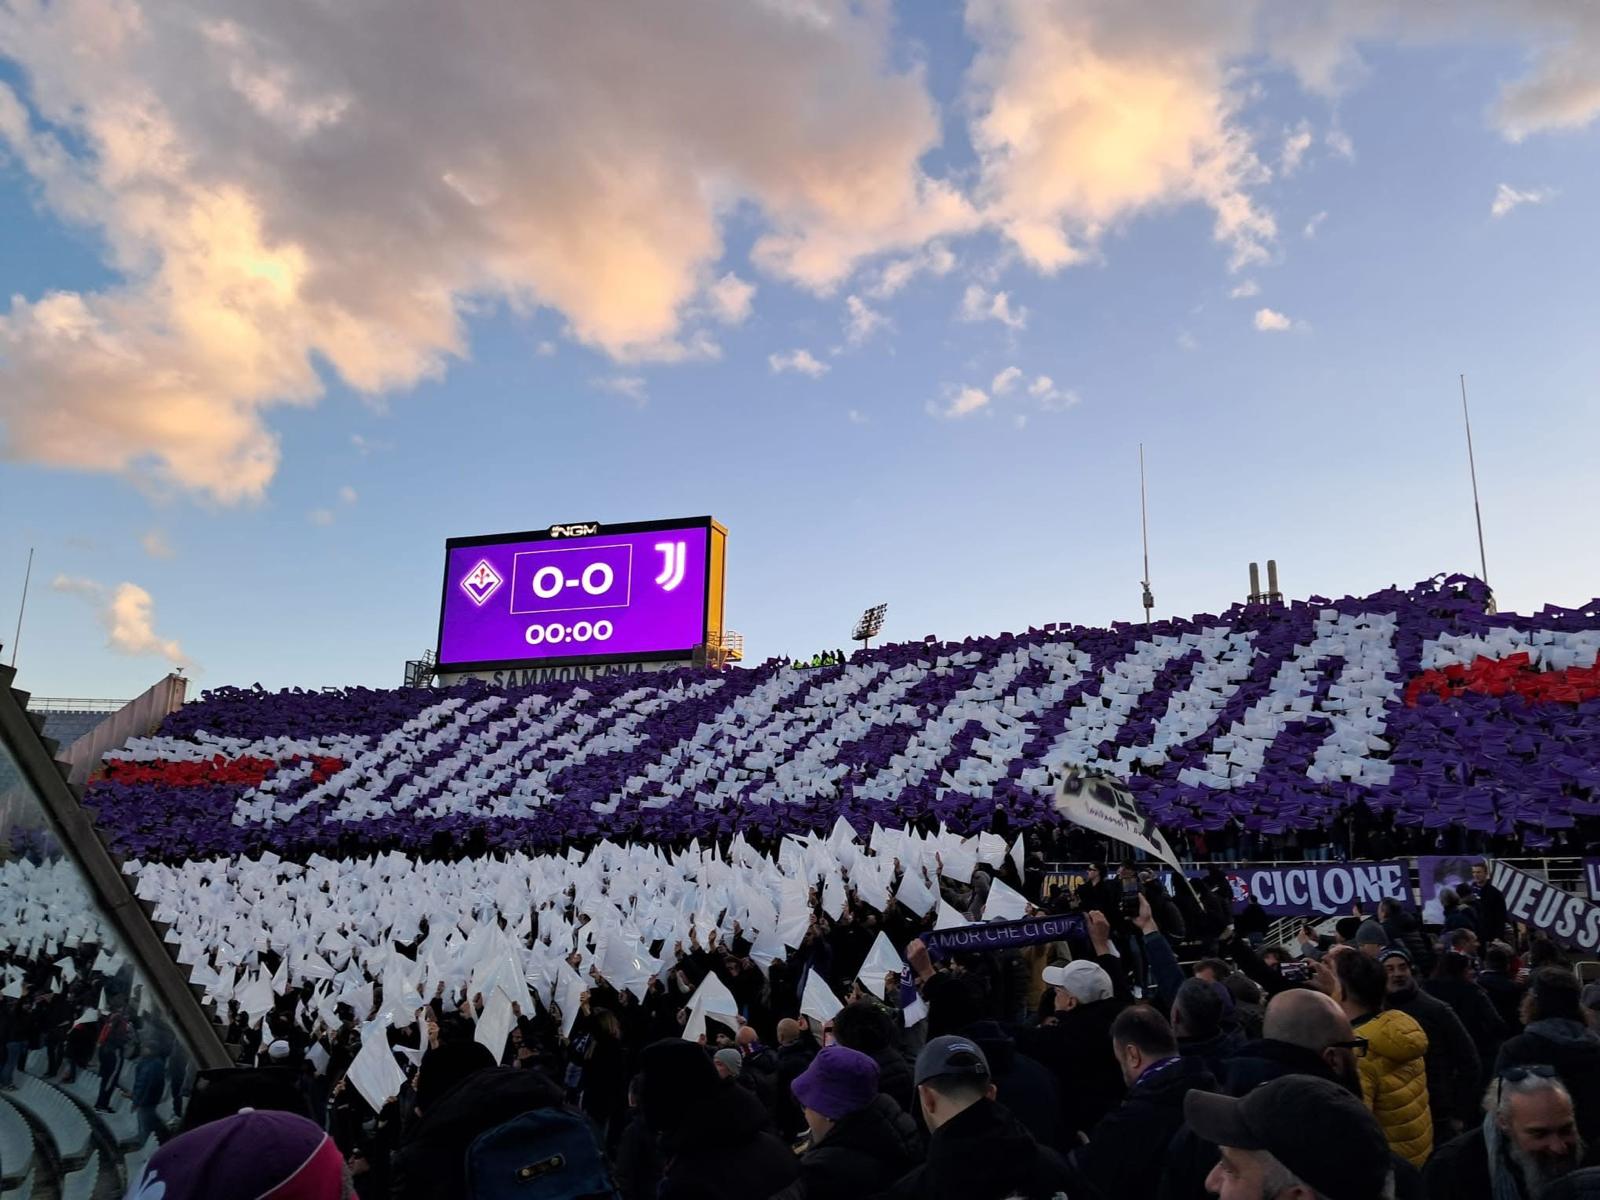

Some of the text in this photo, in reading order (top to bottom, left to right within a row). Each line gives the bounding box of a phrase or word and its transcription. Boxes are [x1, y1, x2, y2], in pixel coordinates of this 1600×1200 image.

[532, 562, 613, 599] 0-0
[525, 620, 613, 645] 00:00
[1251, 865, 1406, 914] CICLONE
[1587, 864, 1600, 901] L
[1491, 861, 1600, 953] VIEUSS
[985, 925, 1020, 942] CHE
[1024, 923, 1039, 937] CI
